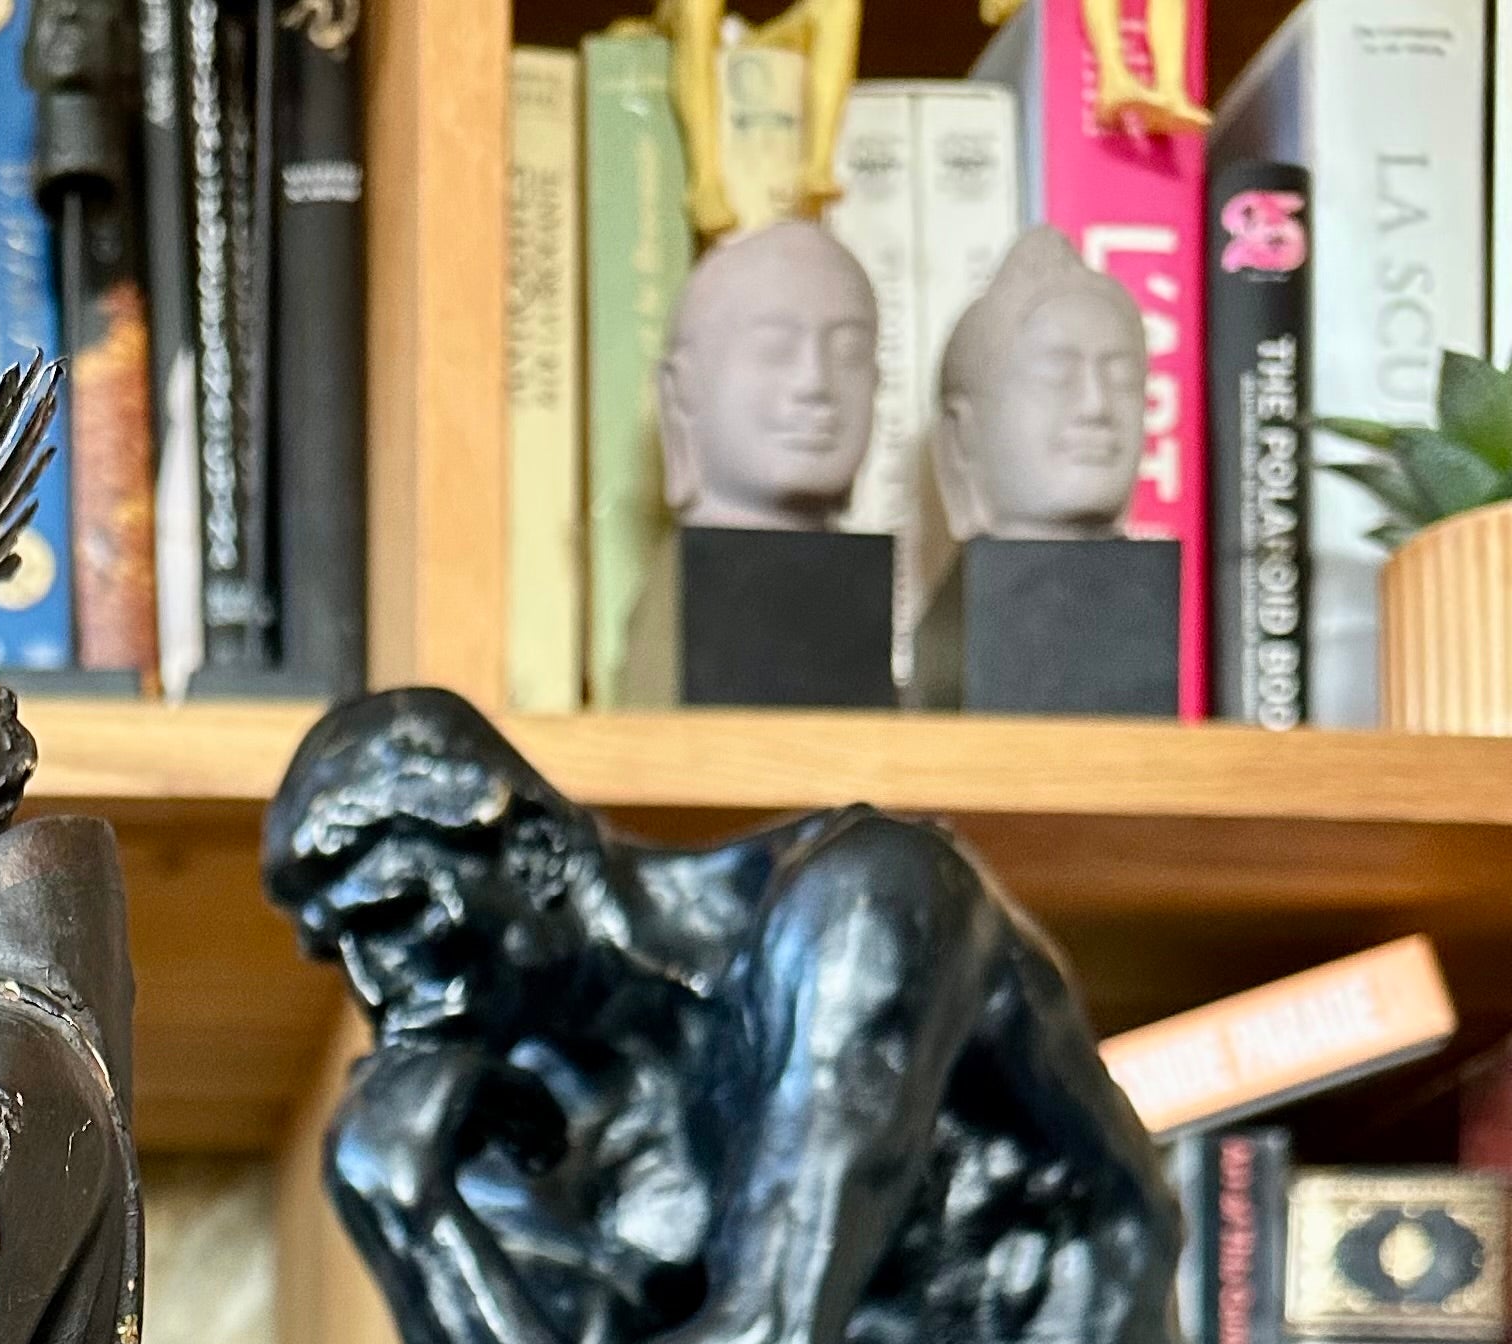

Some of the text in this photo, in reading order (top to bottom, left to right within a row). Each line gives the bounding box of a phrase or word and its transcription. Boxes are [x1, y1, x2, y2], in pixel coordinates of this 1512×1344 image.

[1377, 151, 1435, 412] LA SCU
[1256, 336, 1297, 420] THE
[1260, 641, 1302, 731] BOO
